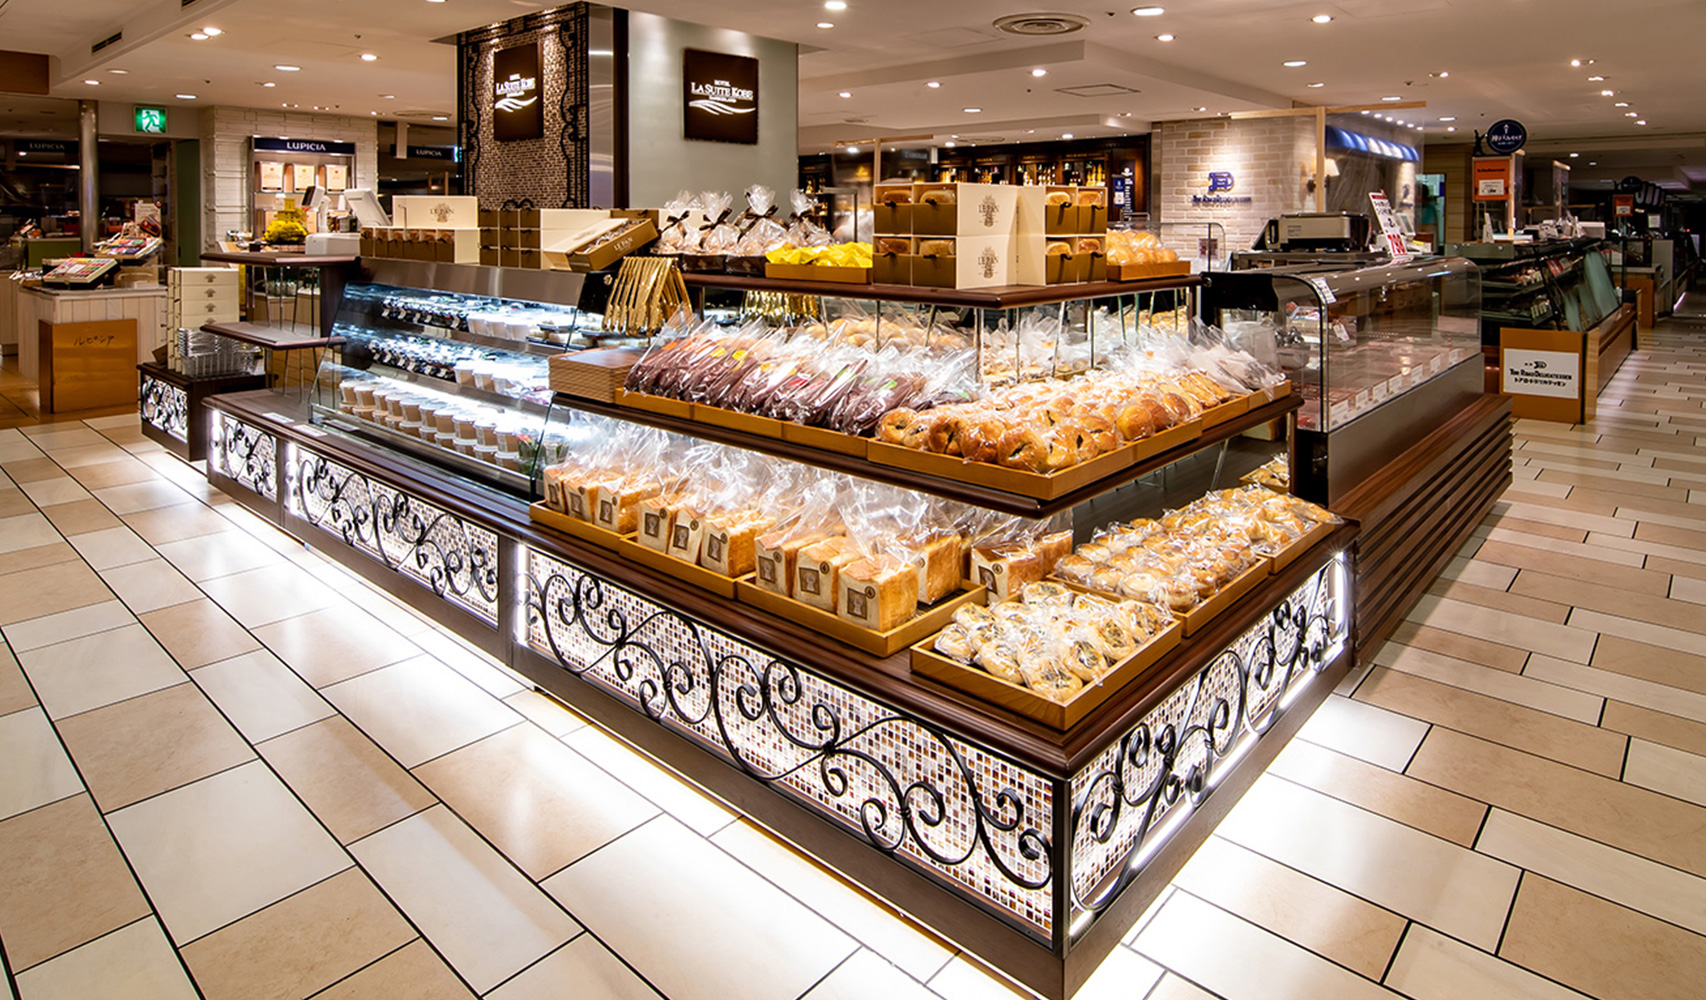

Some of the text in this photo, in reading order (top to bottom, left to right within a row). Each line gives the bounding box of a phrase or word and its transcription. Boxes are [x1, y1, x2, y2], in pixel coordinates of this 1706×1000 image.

[496, 82, 506, 95] LA
[691, 82, 705, 95] LA
[705, 83, 731, 97] SUITE
[731, 87, 754, 100] KOBE
[29, 142, 65, 150] LUPICIA
[286, 141, 326, 151] LUPICIA
